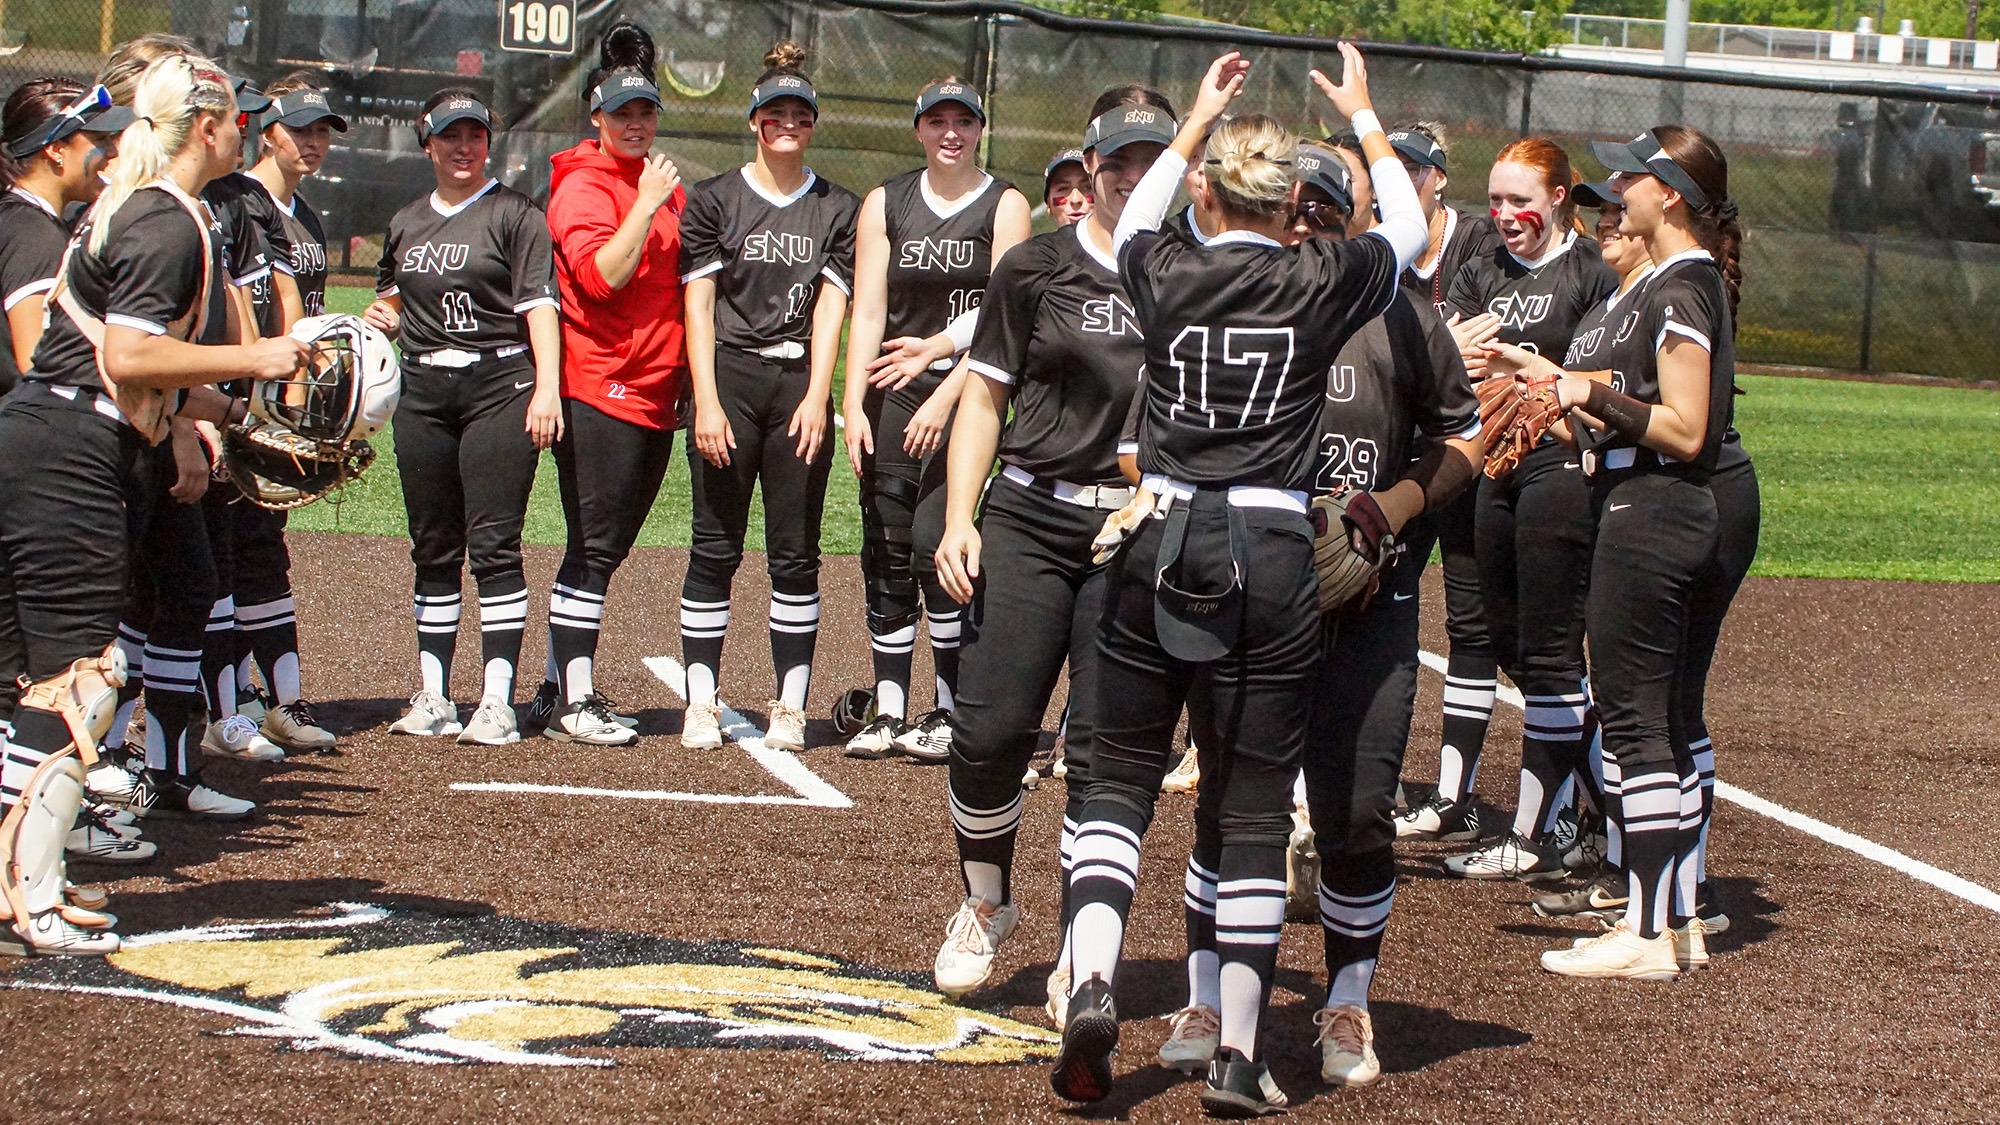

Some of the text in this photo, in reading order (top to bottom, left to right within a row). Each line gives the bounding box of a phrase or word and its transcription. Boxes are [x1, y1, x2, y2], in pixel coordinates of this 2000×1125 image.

[509, 2, 569, 44] 190
[621, 76, 644, 88] SNU
[778, 77, 801, 88] SNU
[939, 84, 963, 95] SNU
[449, 99, 472, 110] SNU
[1124, 109, 1155, 124] SNU
[1297, 156, 1320, 171] NU
[402, 241, 470, 275] SNU
[743, 230, 813, 266] SNU
[899, 236, 974, 273] SNU
[442, 292, 478, 332] 11
[1082, 293, 1145, 340] SN
[1488, 290, 1553, 332] SNU
[607, 383, 626, 399] 22
[1169, 325, 1294, 429] 17
[1315, 433, 1379, 493] 29
